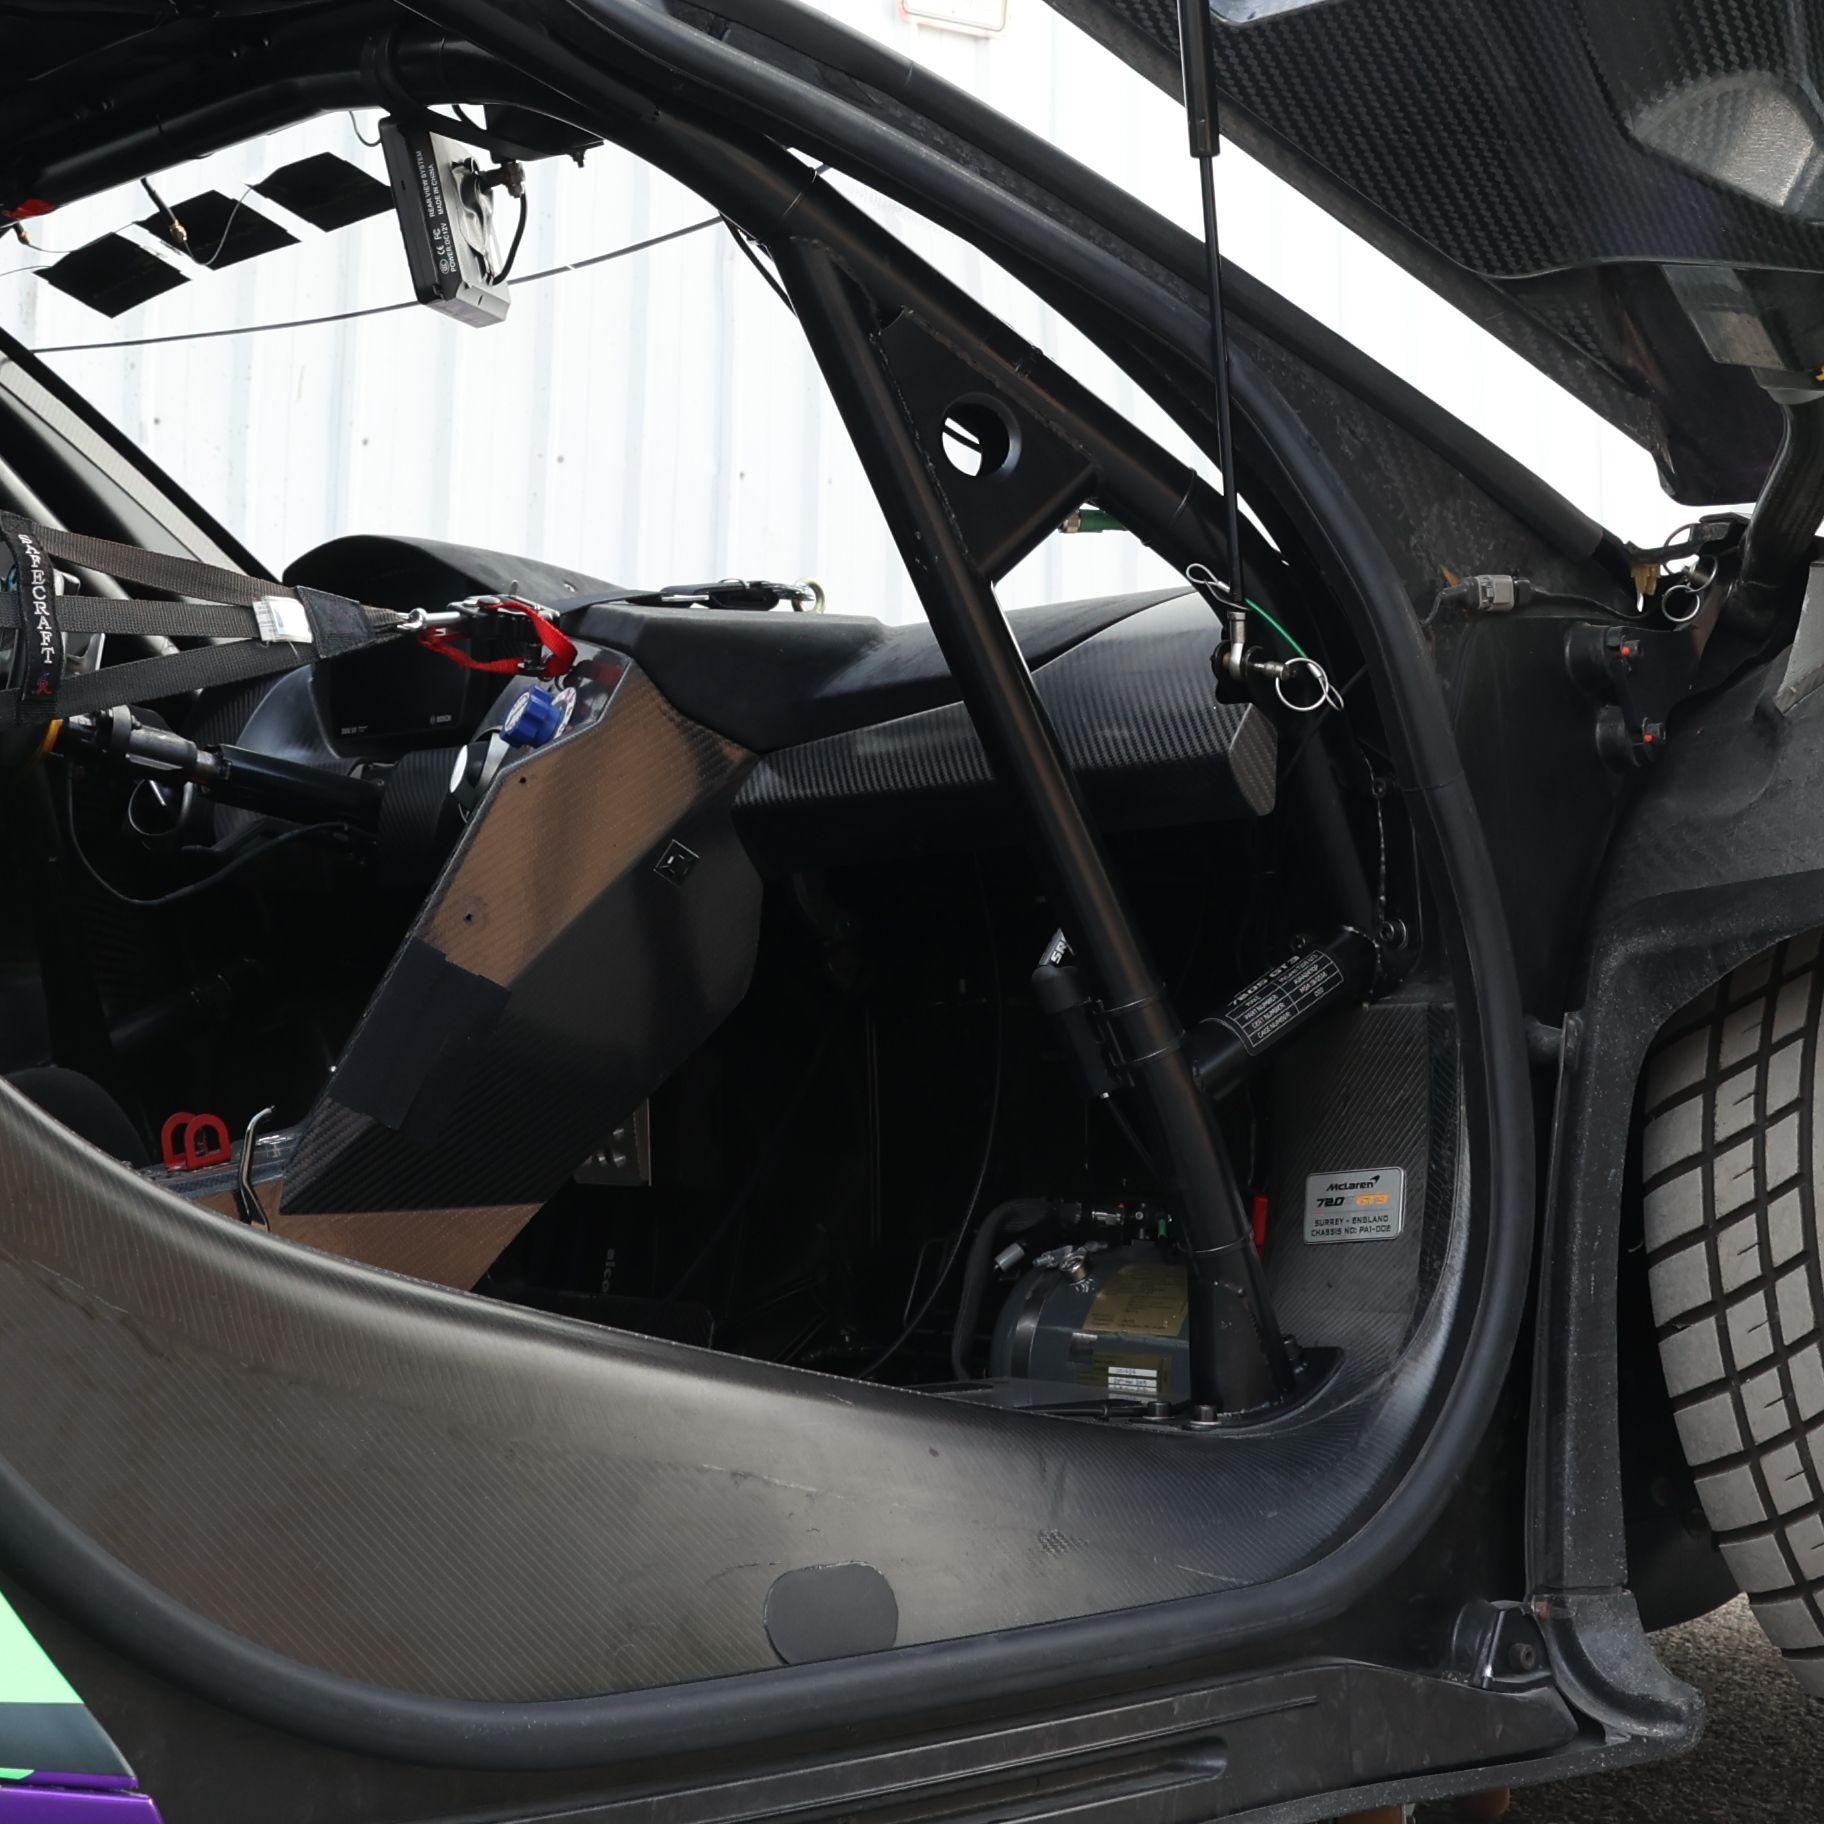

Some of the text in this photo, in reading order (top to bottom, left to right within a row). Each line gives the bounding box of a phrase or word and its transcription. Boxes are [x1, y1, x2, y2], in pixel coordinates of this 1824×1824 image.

[415, 150, 435, 217] REAR VIEW SYSTEM
[427, 164, 444, 214] MADE IN CHINA
[17, 534, 56, 665] SAFECRAFT
[1326, 1181, 1374, 1192] McLaren
[1311, 1227, 1342, 1236] CHASSIS
[1314, 1218, 1344, 1227] SURREY
[1352, 1215, 1389, 1225] ENGLAND
